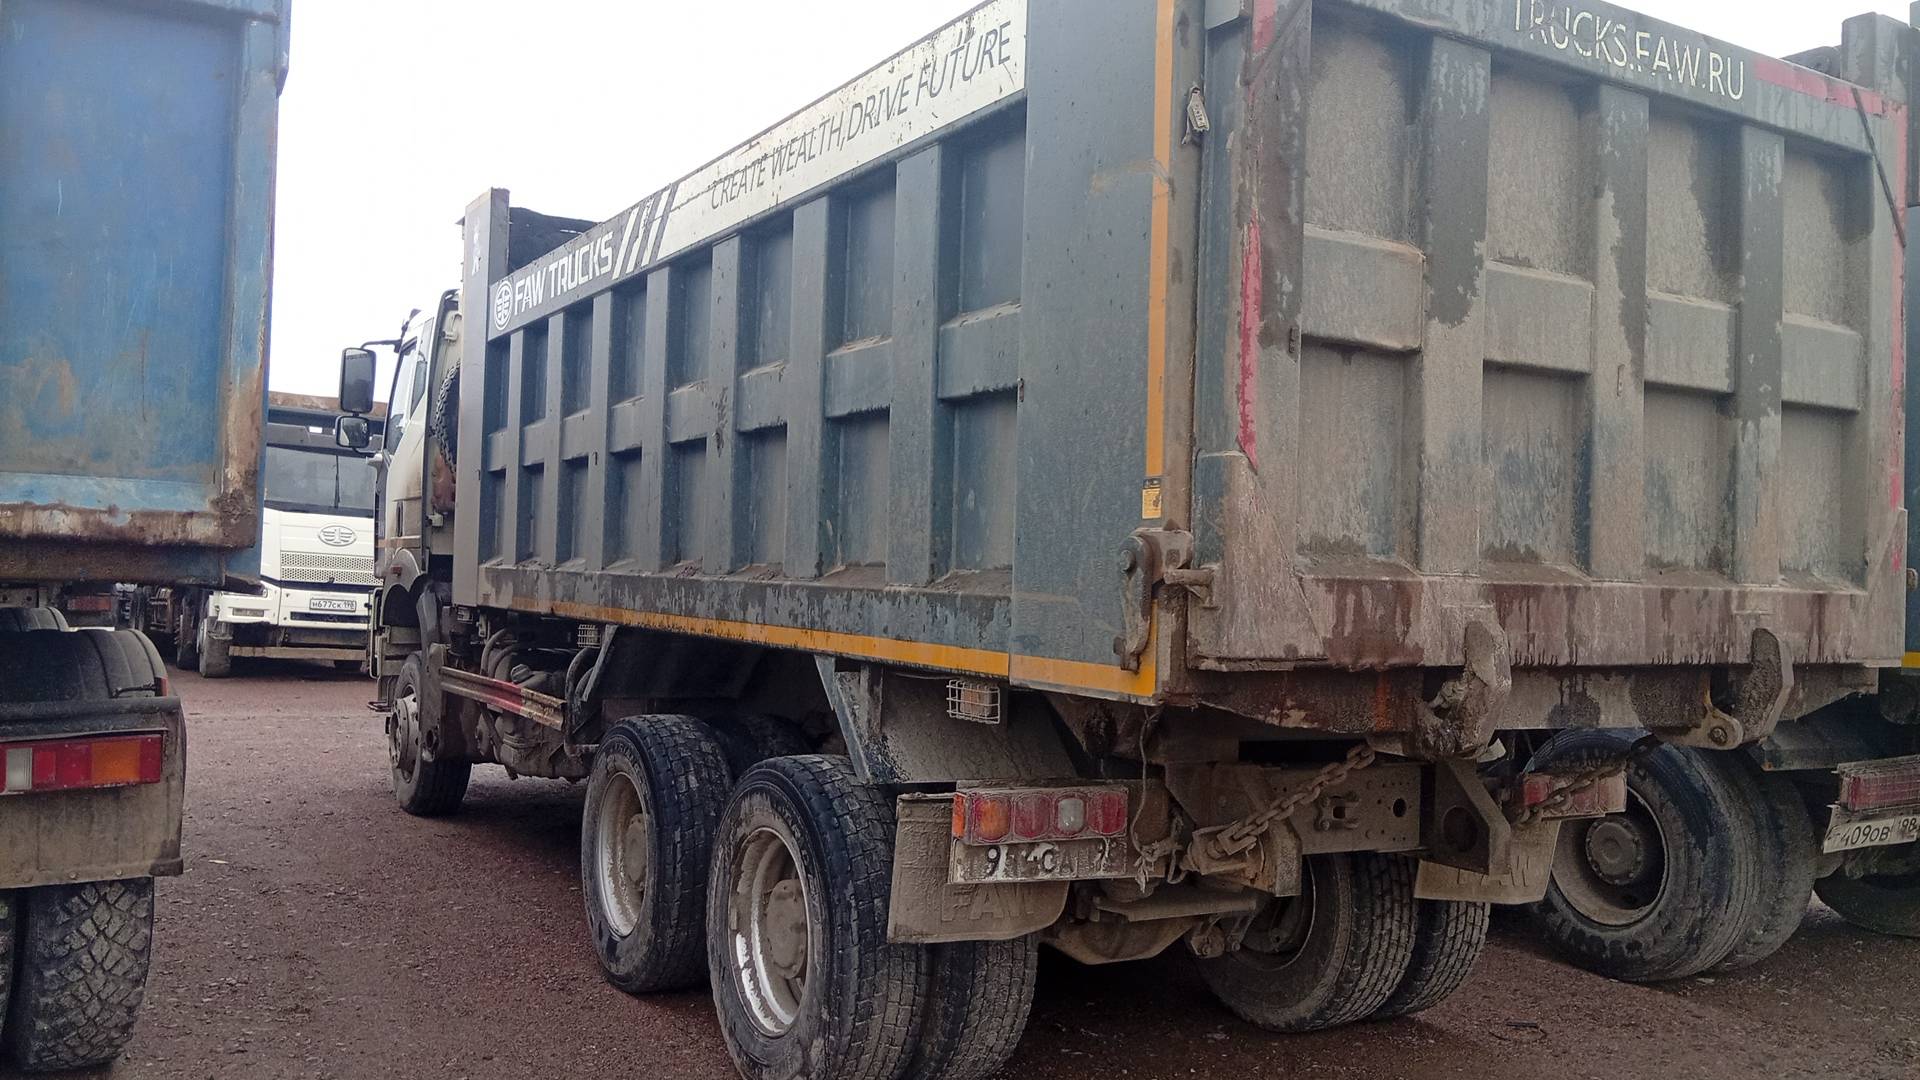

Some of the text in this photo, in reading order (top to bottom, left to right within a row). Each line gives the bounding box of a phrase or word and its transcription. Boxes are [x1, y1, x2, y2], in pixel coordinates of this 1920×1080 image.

[711, 156, 768, 210] CREATE
[915, 20, 1011, 107] FUTURE
[514, 231, 614, 316] FAW TRUCKS
